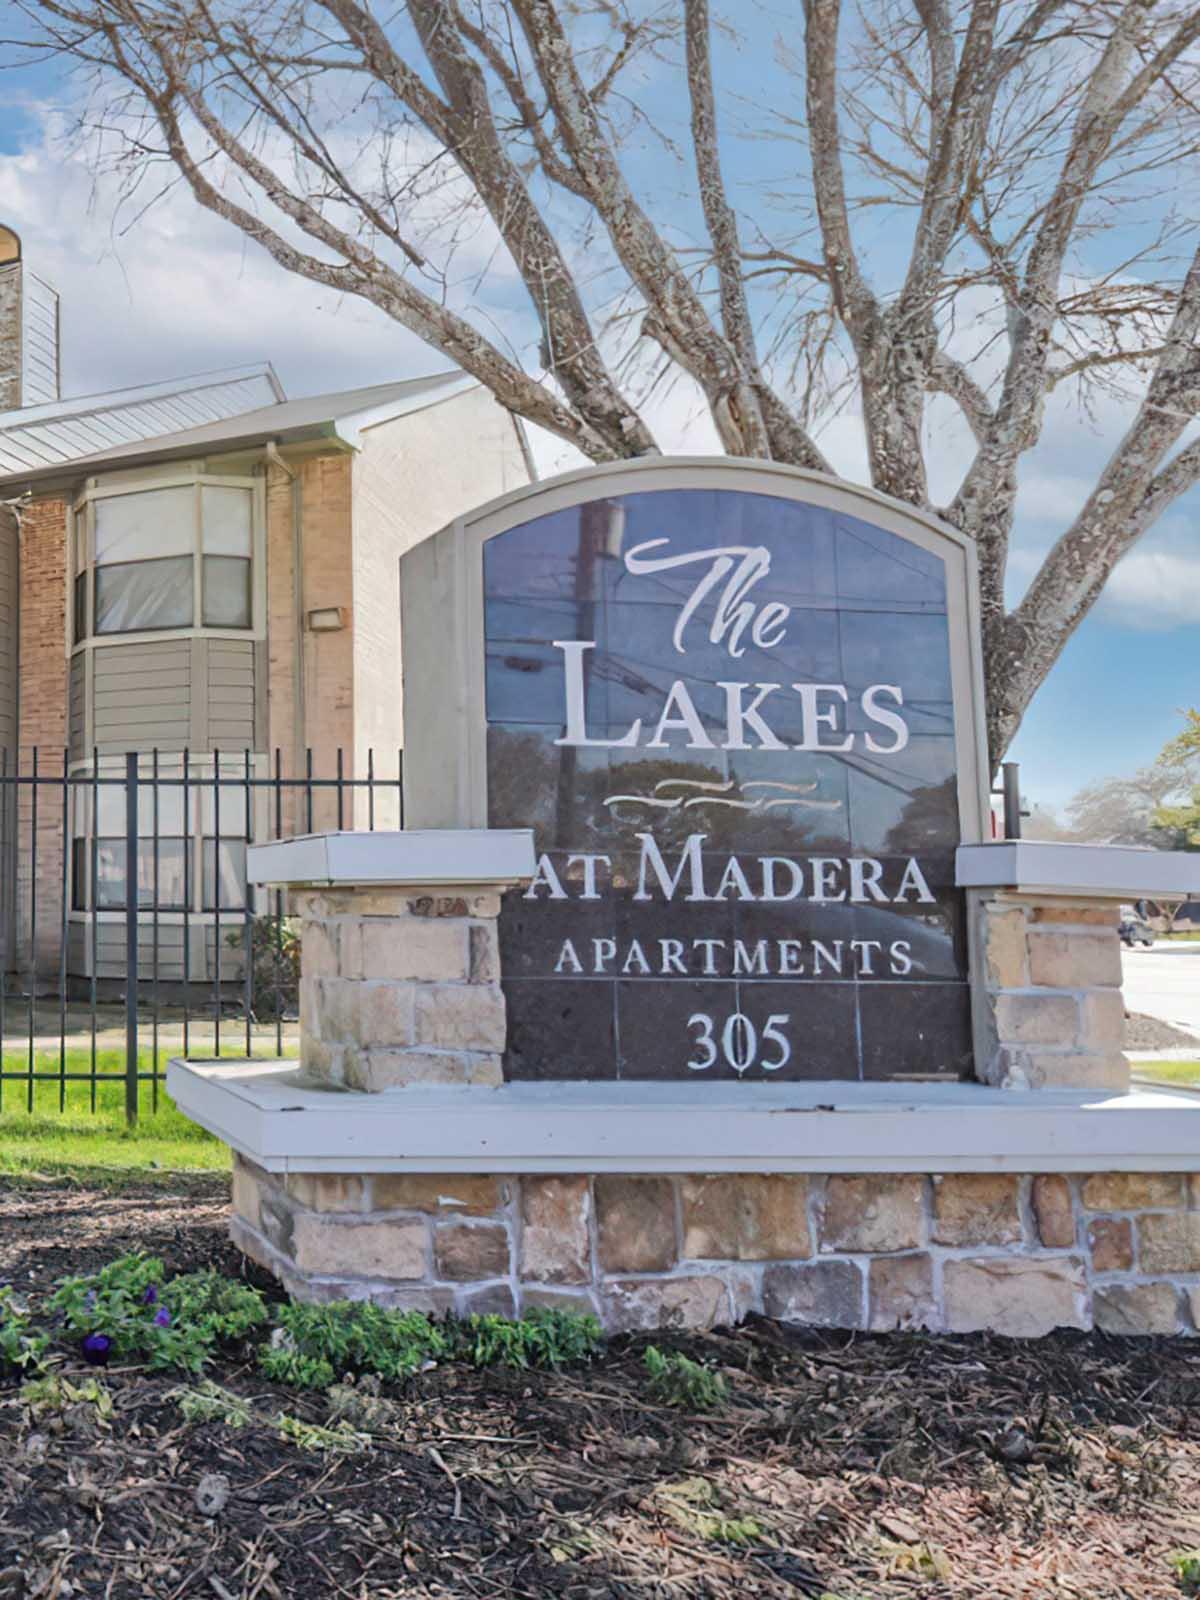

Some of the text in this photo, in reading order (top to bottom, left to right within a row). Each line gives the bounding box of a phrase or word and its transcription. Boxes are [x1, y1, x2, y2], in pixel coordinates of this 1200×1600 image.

[624, 538, 790, 657] The
[552, 640, 910, 753] LAKES
[522, 832, 937, 902] AT MADERA
[553, 939, 913, 975] APARTMENTS
[687, 1014, 792, 1072] 305
